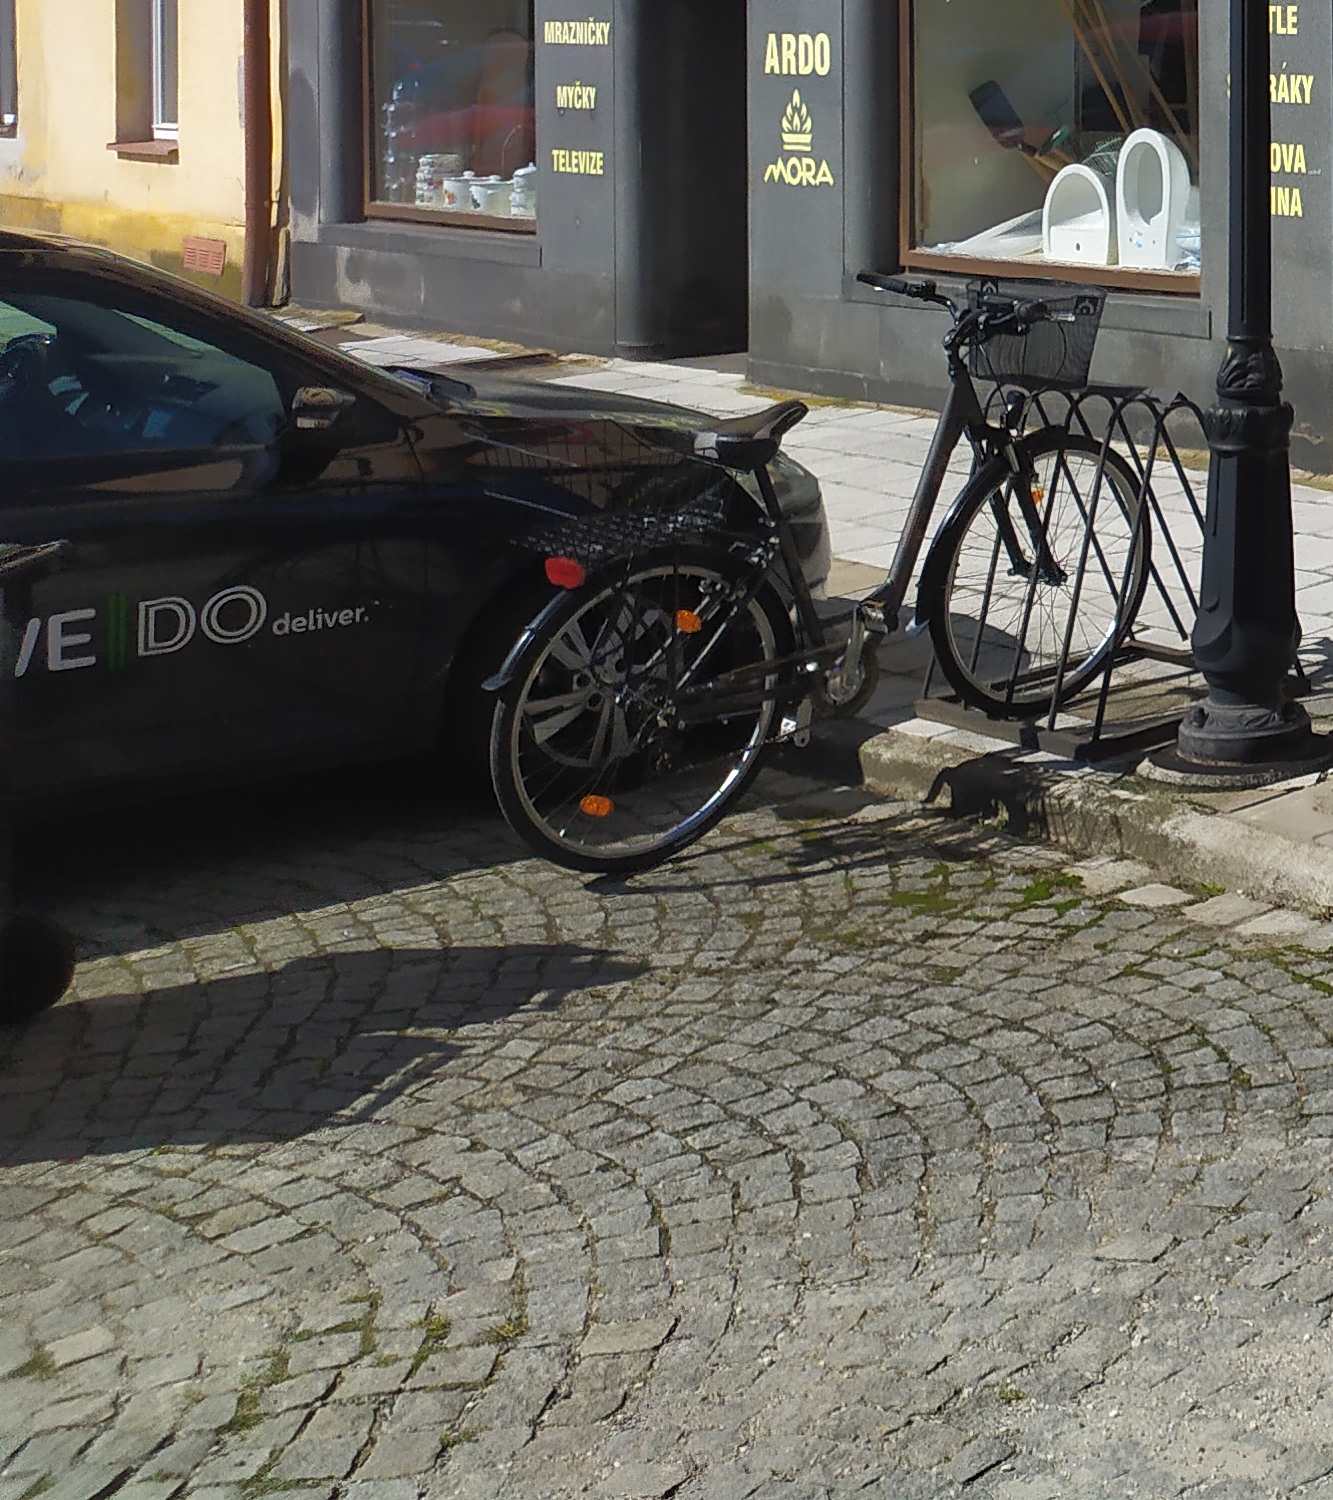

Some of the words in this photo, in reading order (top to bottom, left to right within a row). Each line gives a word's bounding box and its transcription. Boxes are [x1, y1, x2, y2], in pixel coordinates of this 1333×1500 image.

[544, 16, 611, 46] MRAZNIČKY
[764, 32, 831, 77] ARDO
[556, 80, 597, 109] MYČKY
[551, 149, 604, 175] TELEVIZE
[763, 156, 835, 186] MORA
[272, 606, 370, 636] deliver.
